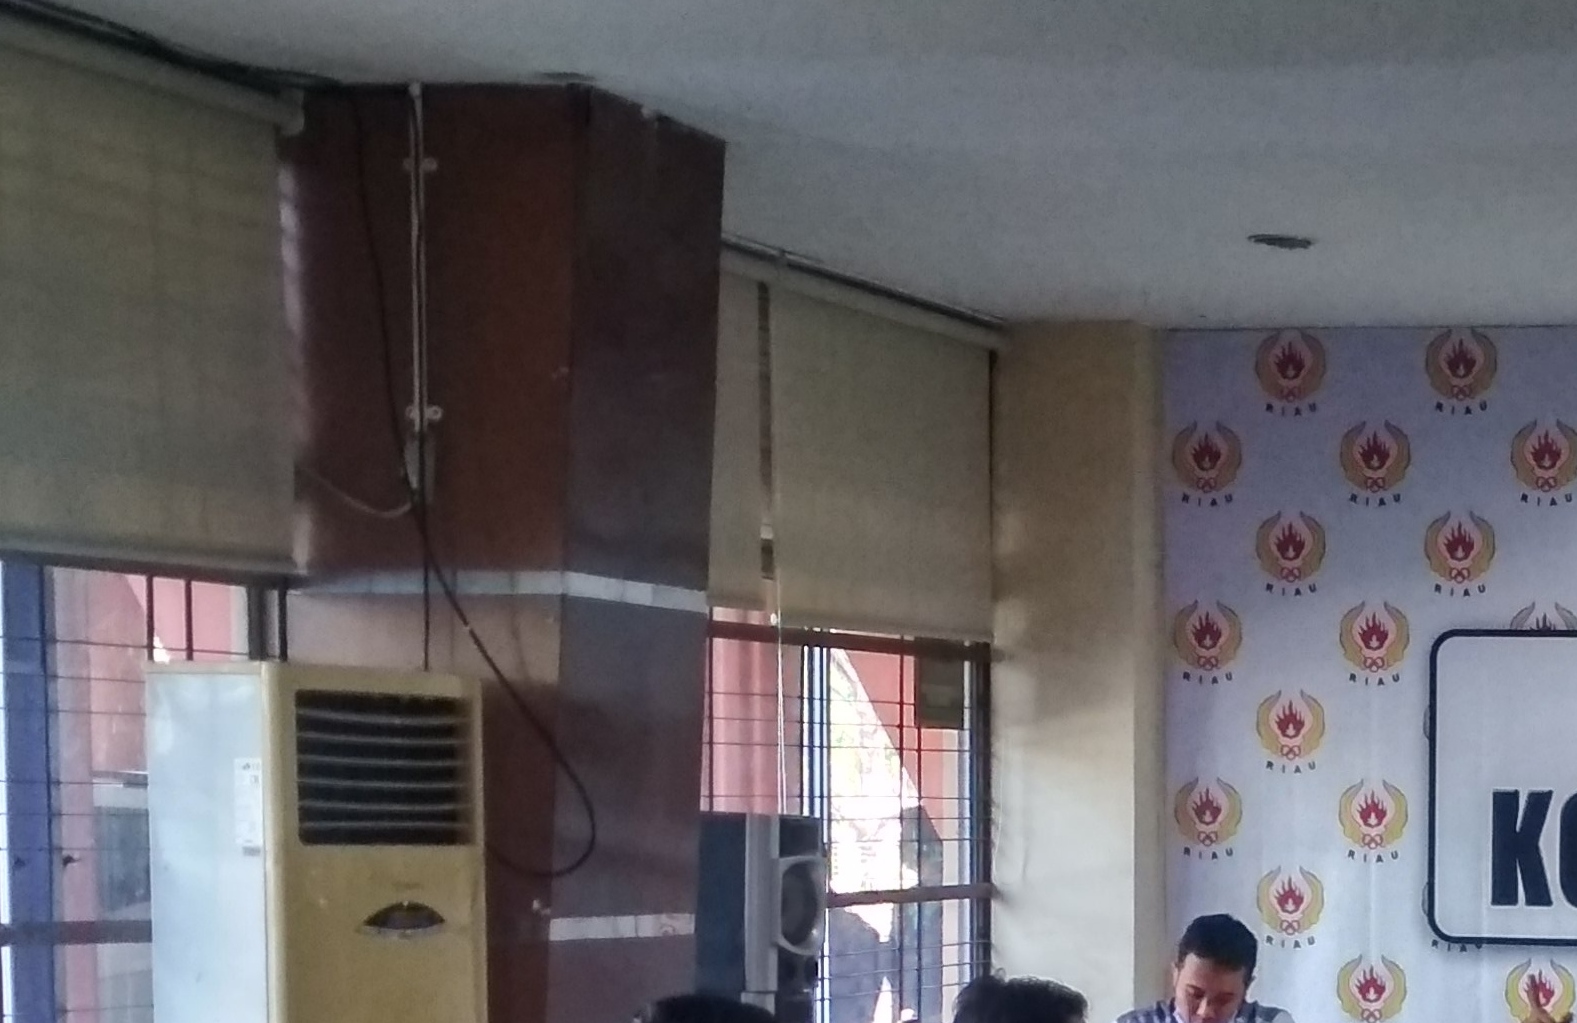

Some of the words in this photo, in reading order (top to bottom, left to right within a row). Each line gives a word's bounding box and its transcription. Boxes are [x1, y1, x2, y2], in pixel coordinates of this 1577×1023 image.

[1265, 402, 1318, 417] RIAU
[1434, 399, 1488, 416] RIAU
[1181, 491, 1234, 508] RIAU
[1348, 492, 1401, 508] RIAU
[1520, 492, 1573, 507] RIAU
[1265, 582, 1318, 597] RIAU
[1434, 583, 1487, 598] RIAU
[1182, 671, 1233, 685] RIAU
[1348, 672, 1400, 687] RIAU
[1265, 760, 1316, 774] RIAU
[1183, 846, 1234, 861] RIAU
[1347, 848, 1399, 864] RIAU
[1265, 934, 1316, 949] RIAU
